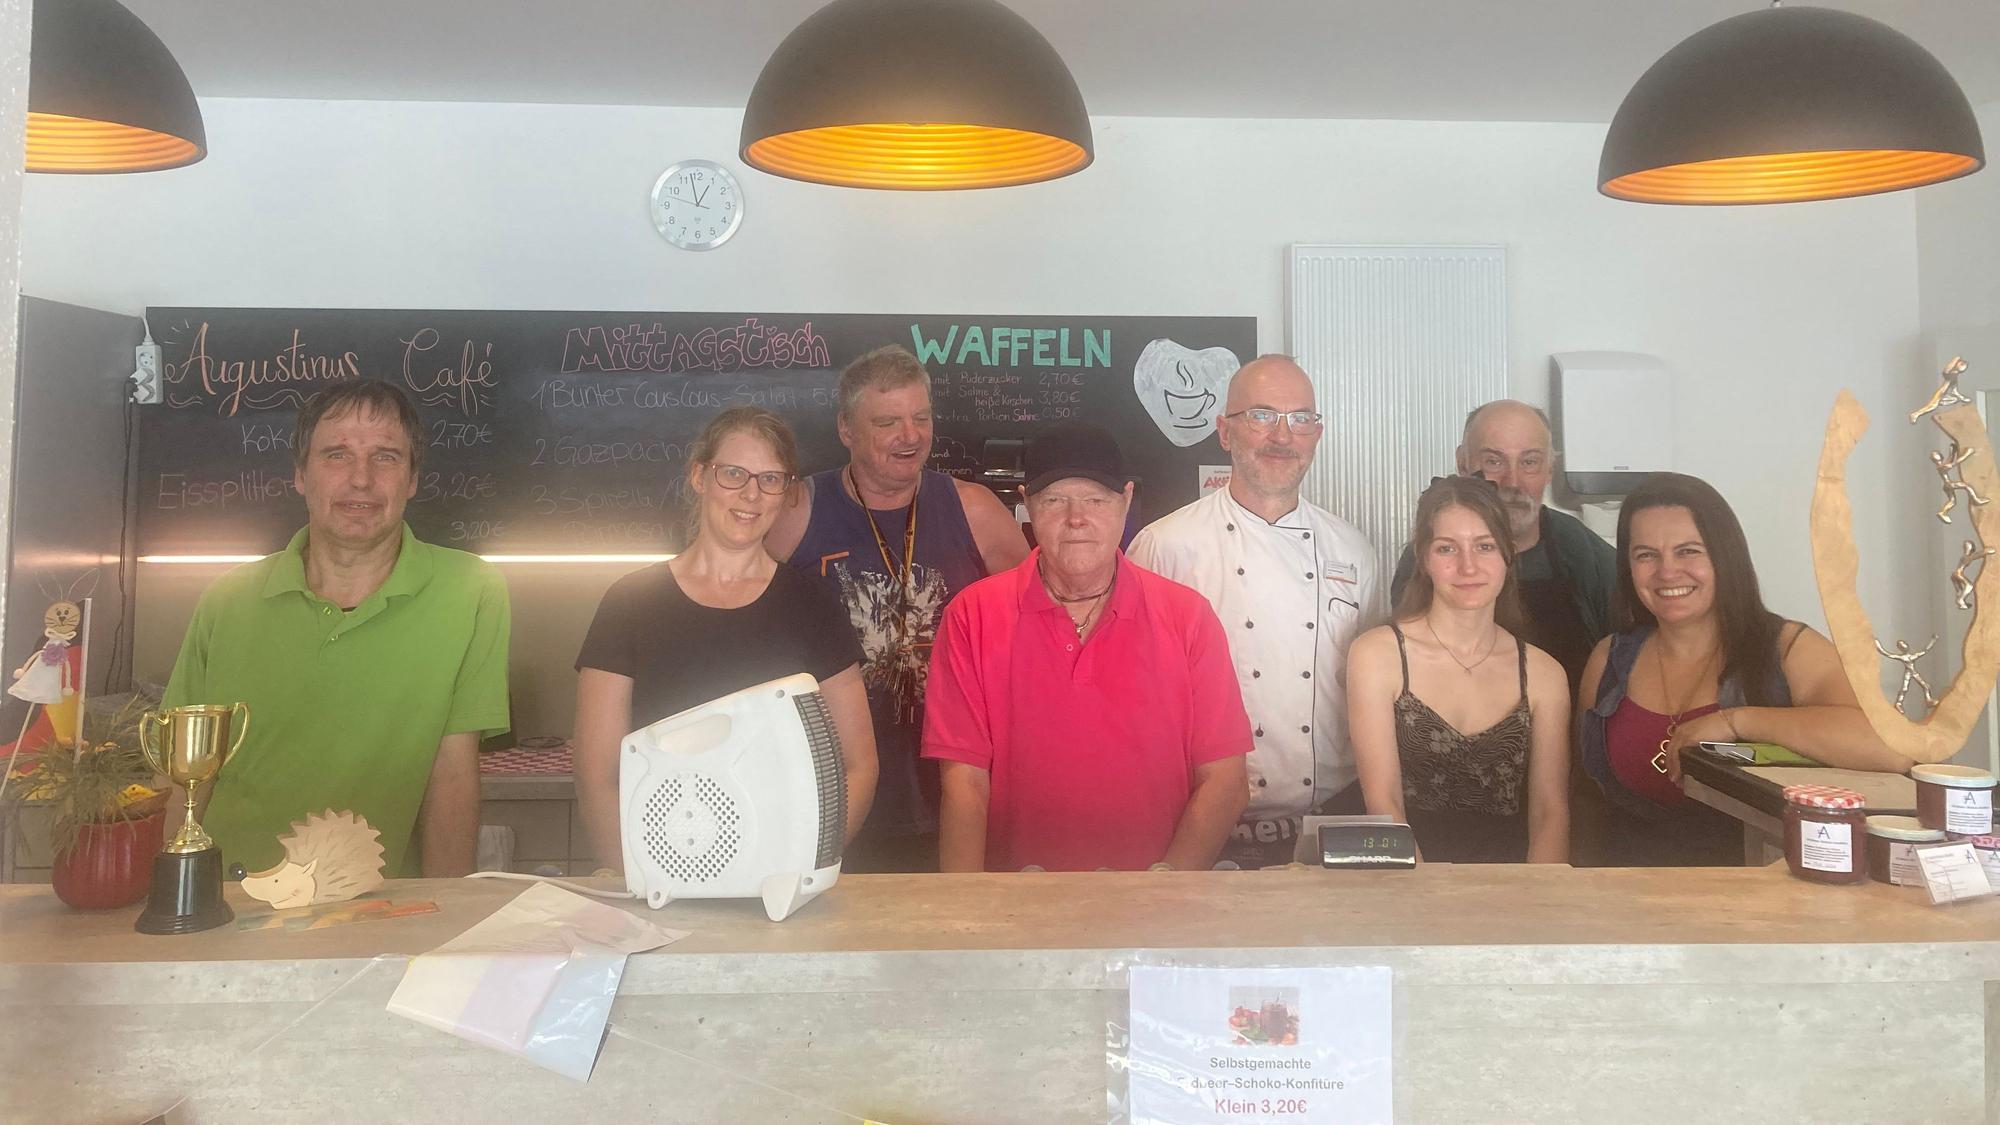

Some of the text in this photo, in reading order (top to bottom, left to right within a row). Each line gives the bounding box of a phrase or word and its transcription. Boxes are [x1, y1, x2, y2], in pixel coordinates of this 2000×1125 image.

[680, 176, 688, 185] 11
[692, 172, 703, 181] 12
[669, 186, 680, 195] 10
[720, 187, 727, 195] 2
[663, 202, 671, 210] 9
[725, 202, 731, 210] 3
[668, 216, 675, 224] 8
[721, 216, 727, 224] 4
[681, 227, 687, 235] 7
[694, 230, 701, 238] 6
[709, 227, 716, 236] 5
[910, 324, 1111, 367] WAFFELN
[163, 322, 498, 417] Augustinus Café
[960, 371, 1023, 385] Puderzucker
[1039, 372, 1085, 388] 2,70€
[549, 380, 629, 409] Bunter
[430, 419, 493, 449] 2,70€
[416, 472, 497, 503] 3,20€
[1210, 1057, 1312, 1071] Selbstgemachte
[1215, 1098, 1308, 1117] Klein 3,20€
